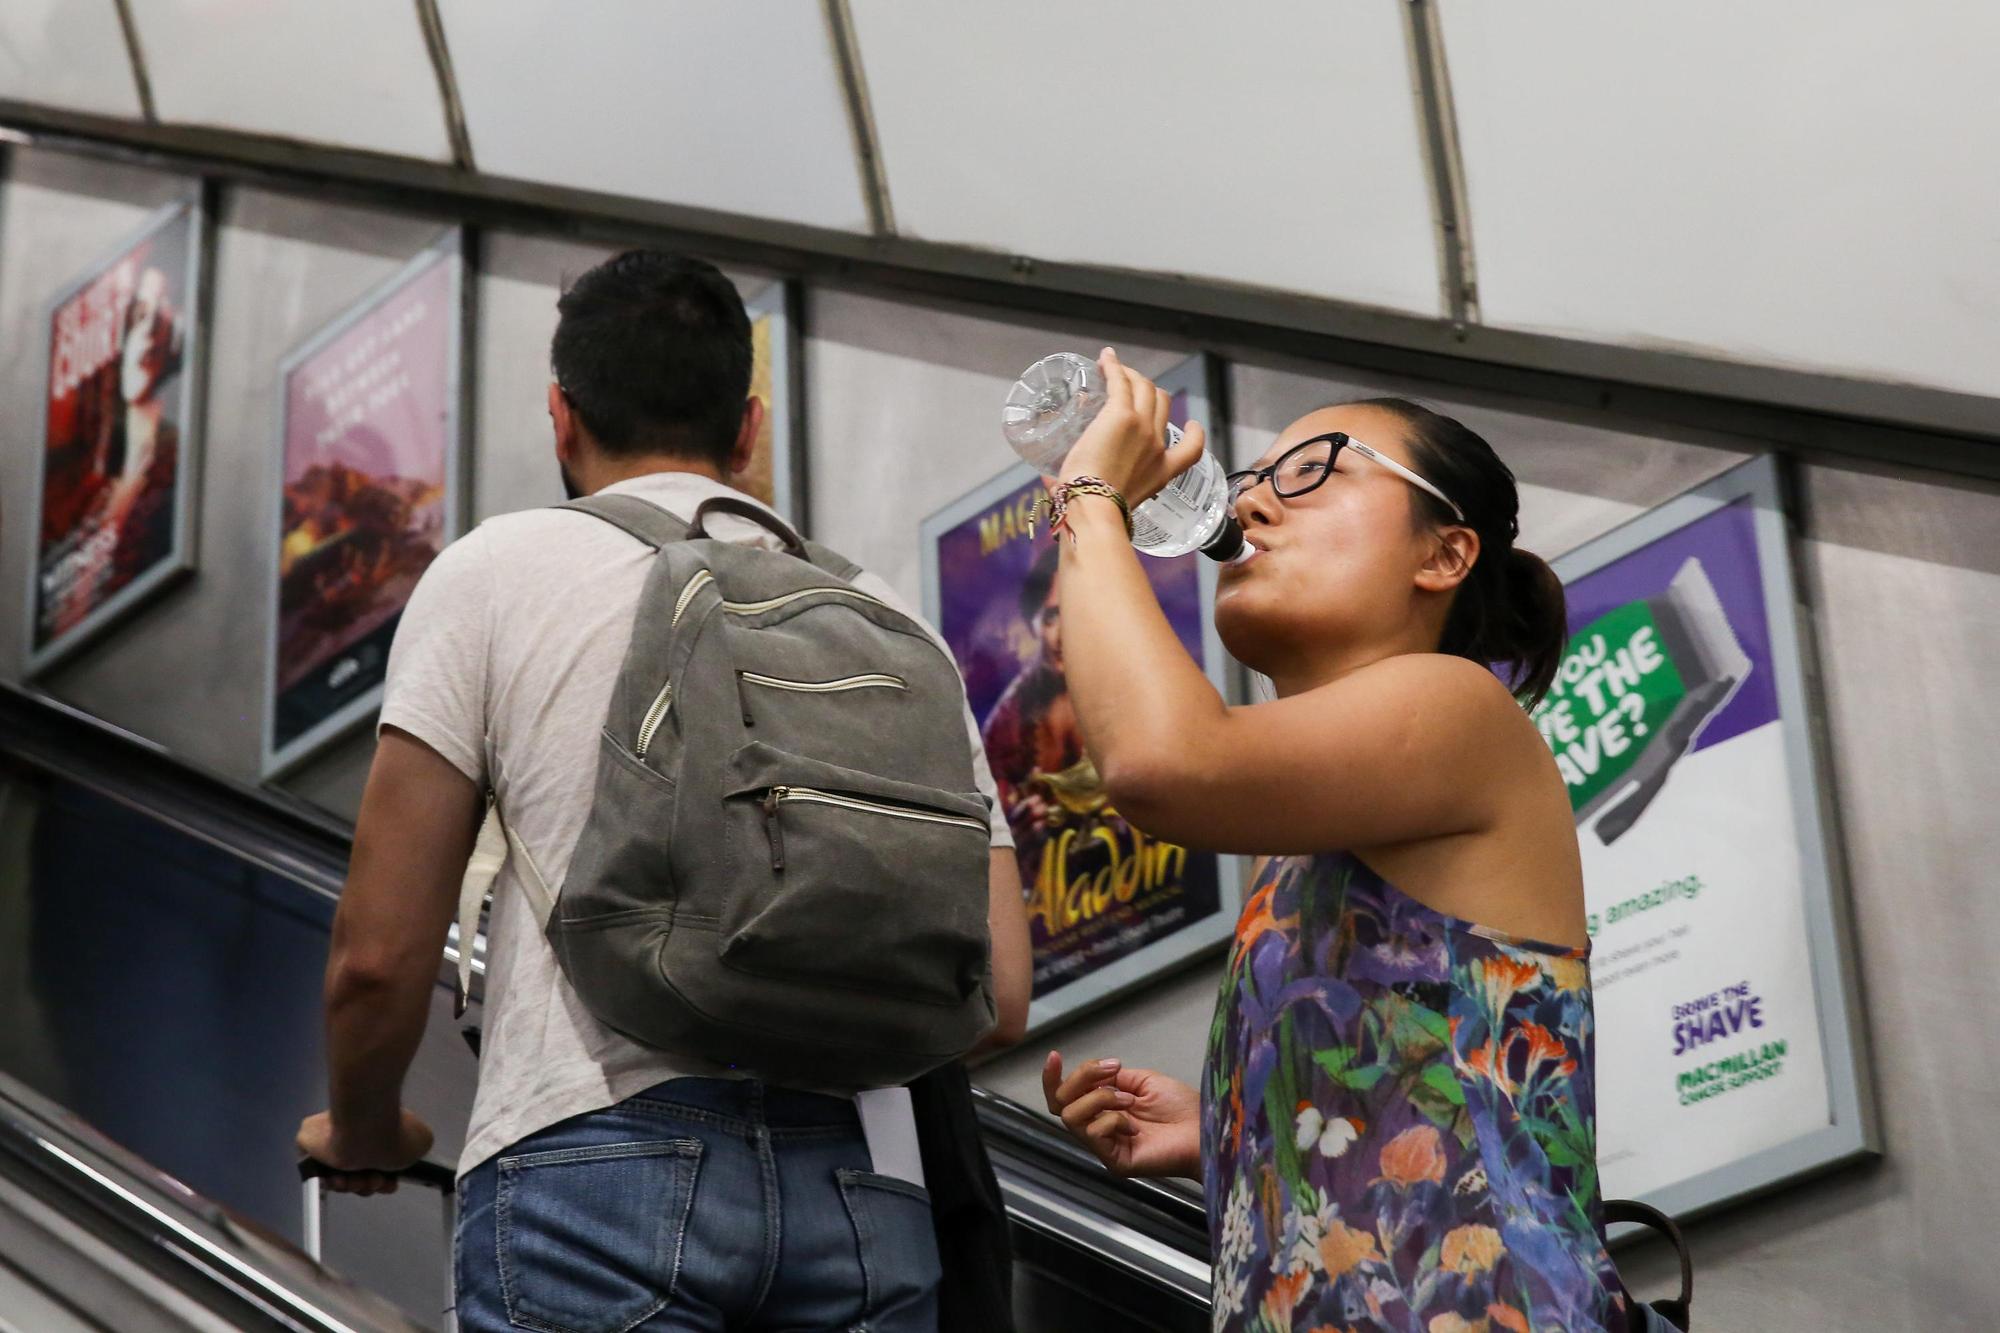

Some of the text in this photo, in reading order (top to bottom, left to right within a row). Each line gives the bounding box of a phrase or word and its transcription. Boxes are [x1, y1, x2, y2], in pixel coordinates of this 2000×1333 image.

[1573, 625, 1664, 717] THE
[1027, 807, 1187, 936] Aladdin
[1722, 980, 1749, 1000] THE
[1672, 996, 1763, 1056] SHAVE
[1676, 1038, 1788, 1092] MACMILLAN
